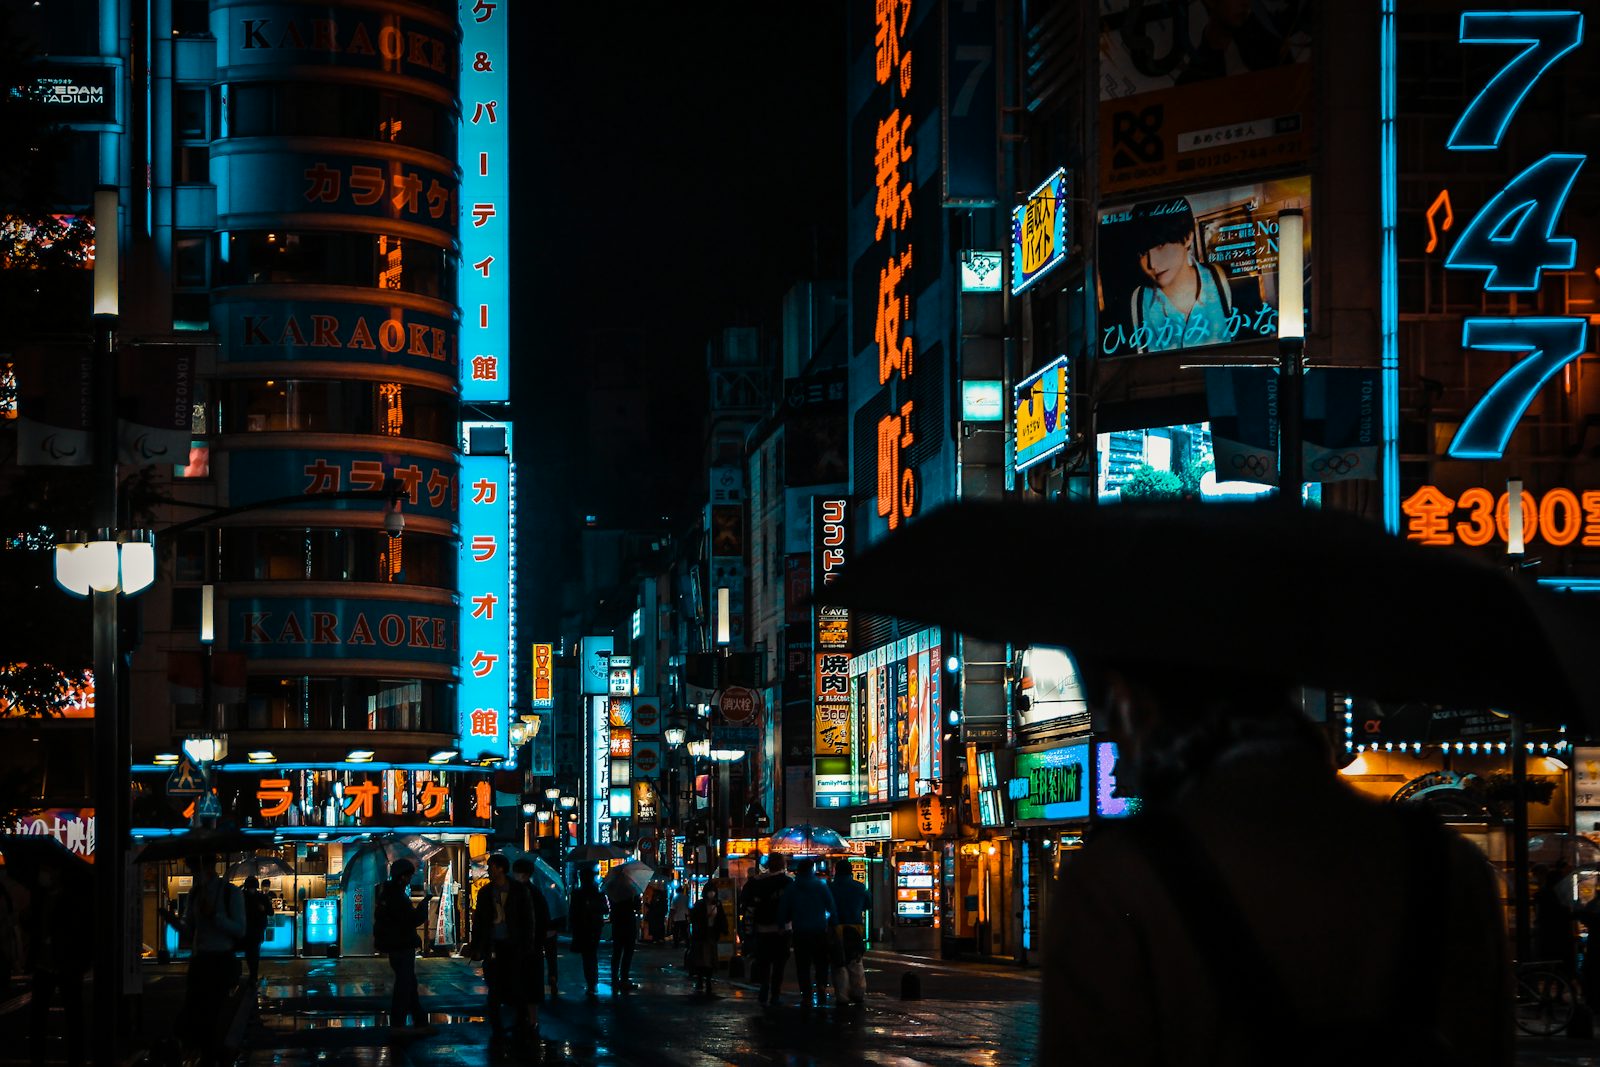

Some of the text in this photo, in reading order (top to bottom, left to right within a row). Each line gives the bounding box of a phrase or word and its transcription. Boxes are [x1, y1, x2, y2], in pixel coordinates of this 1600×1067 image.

[239, 17, 449, 71] KARAOKE
[42, 95, 103, 103] TADIUM
[302, 160, 457, 220] カラオケ
[1445, 10, 1588, 459] 747
[241, 313, 448, 361] KARAOKE
[1224, 302, 1308, 338] かな
[302, 458, 457, 508] カラオケ
[239, 609, 448, 650] KARAOKE
[470, 477, 499, 737] カラオケ館
[820, 654, 849, 695] 焼肉
[723, 698, 751, 712] 消火栓
[181, 778, 493, 820] ラオケ館
